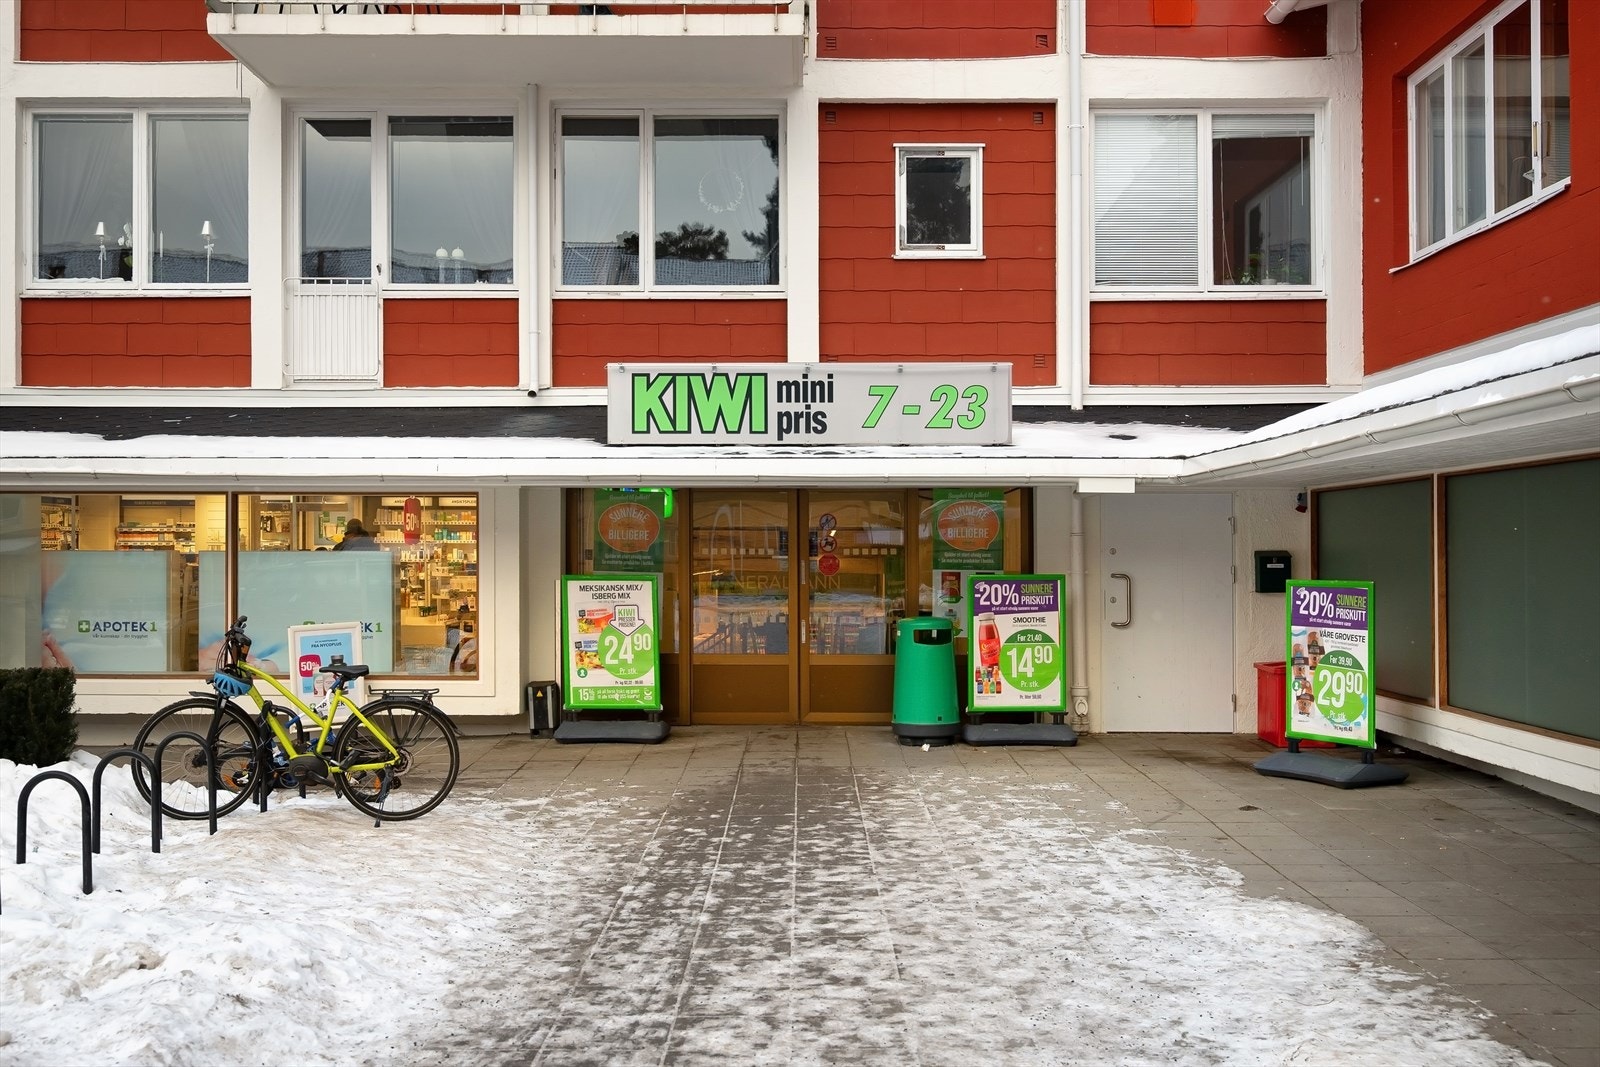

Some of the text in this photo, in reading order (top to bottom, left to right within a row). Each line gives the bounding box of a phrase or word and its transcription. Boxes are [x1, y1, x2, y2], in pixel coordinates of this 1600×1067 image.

[776, 373, 834, 403] mini
[631, 373, 768, 434] KIWI
[861, 385, 898, 429] 7
[924, 385, 989, 429] 23
[776, 405, 828, 441] pris
[608, 507, 650, 523] SUNNERE
[947, 505, 990, 521] SUNNERE
[608, 530, 650, 540] BILLIGERE
[947, 528, 989, 538] BILLIGERE
[579, 584, 643, 592] MEKSIKANSK MIX/
[974, 583, 1054, 606] -20% SUNNERE
[592, 592, 617, 600] ISBERG
[1021, 595, 1054, 605] PRISKUTT
[1295, 588, 1367, 618] -20% SUNNERE
[1335, 607, 1367, 621] PRISKUTT
[93, 621, 157, 632] APOTEK 1
[375, 622, 382, 632] 1
[1320, 629, 1334, 639] VÅRE
[1334, 632, 1366, 643] GROVESTE
[301, 661, 320, 671] 50%
[1338, 656, 1353, 667] 39,90
